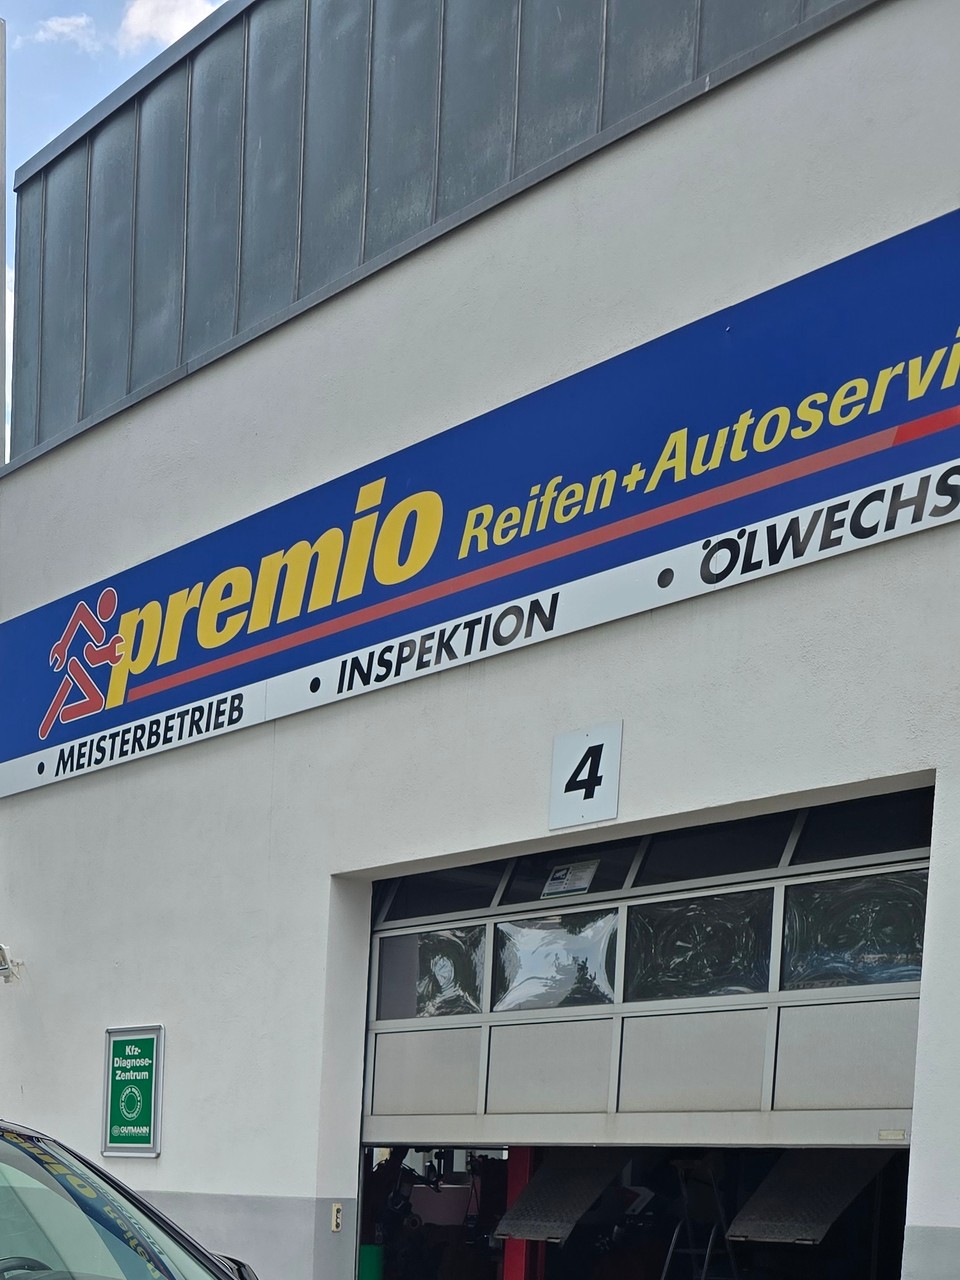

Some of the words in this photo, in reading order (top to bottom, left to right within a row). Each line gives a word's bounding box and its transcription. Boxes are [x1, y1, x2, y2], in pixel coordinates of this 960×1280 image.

[699, 465, 960, 586] ÖLWECHS
[104, 476, 444, 711] premio
[336, 592, 560, 695] INSPEKTION
[54, 692, 245, 777] MEISTERBETRIEB
[563, 743, 604, 801] 4
[113, 1057, 152, 1069] Diagnose-
[115, 1070, 149, 1081] Zentrum
[125, 1045, 141, 1056] Kfz-
[120, 1125, 150, 1134] GUTMANN
